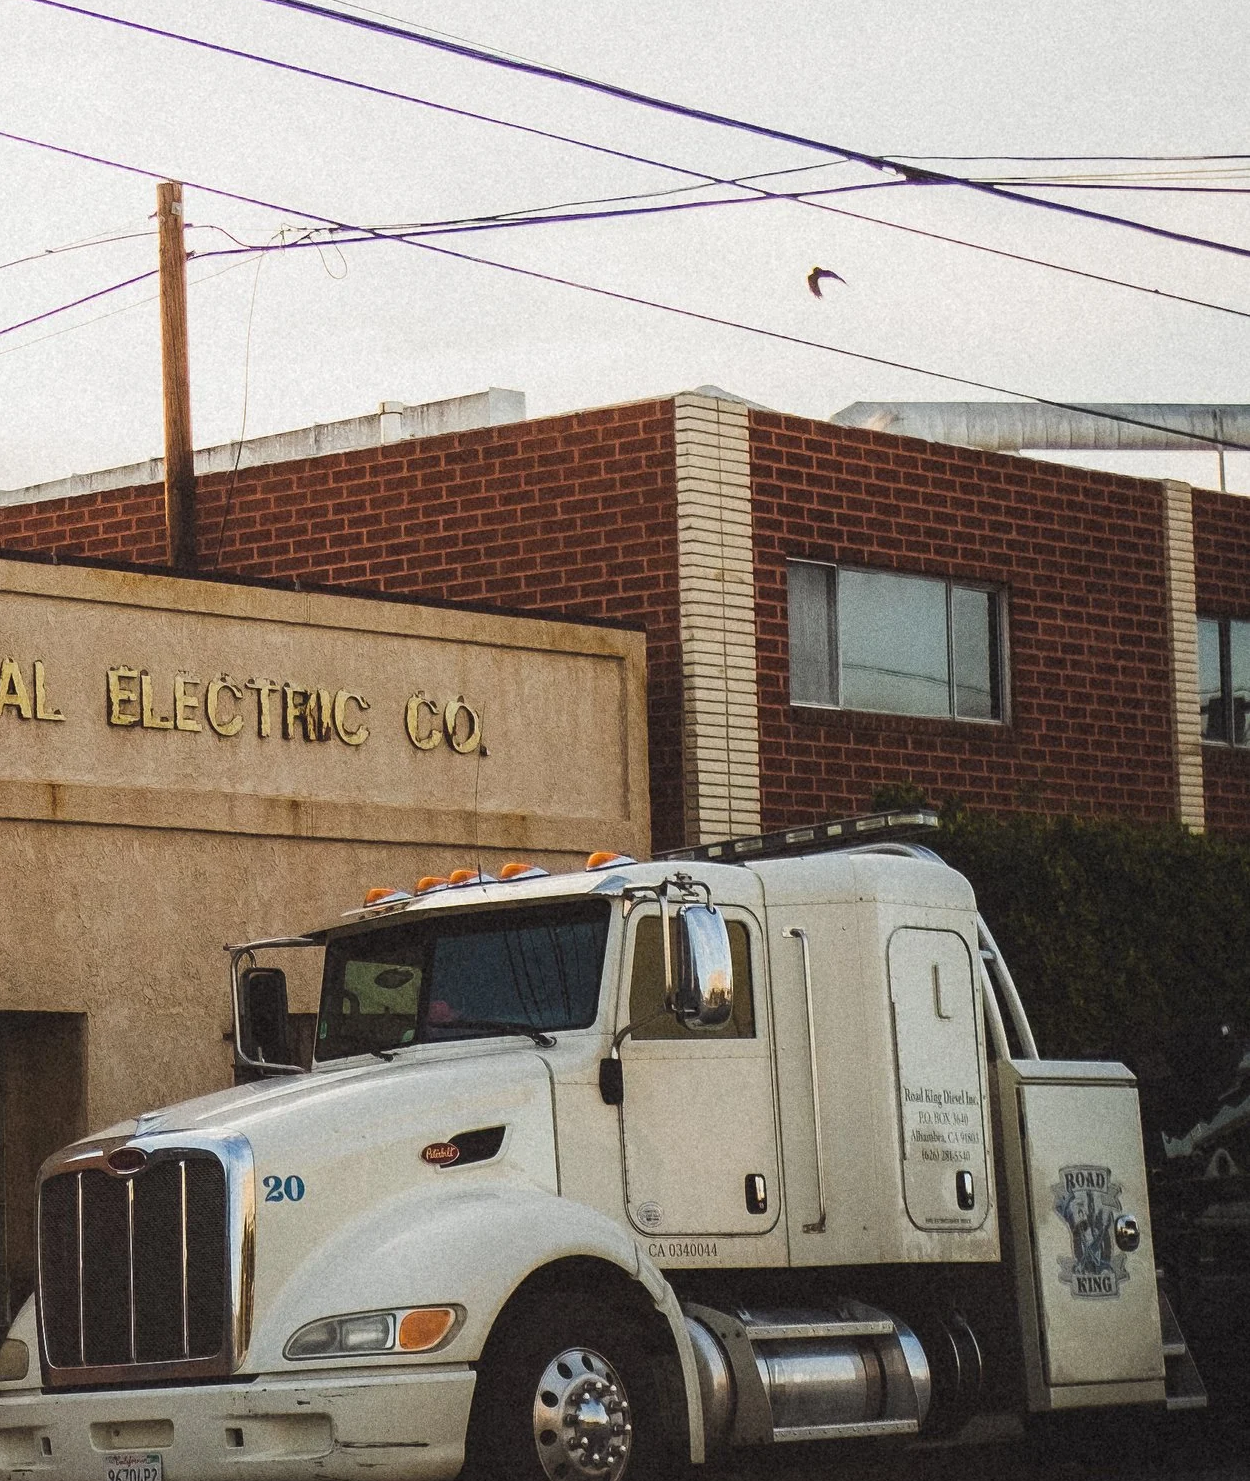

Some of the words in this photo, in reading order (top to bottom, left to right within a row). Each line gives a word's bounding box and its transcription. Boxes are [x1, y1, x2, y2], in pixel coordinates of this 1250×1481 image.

[106, 665, 371, 747] ELECTRIC
[404, 690, 489, 757] CO.
[904, 1087, 924, 1103] Road
[925, 1088, 942, 1108] King
[943, 1089, 965, 1105] Diesel
[965, 1091, 979, 1106] Inc.
[918, 1110, 933, 1125] P.O.
[934, 1112, 950, 1126] BOX
[947, 1131, 959, 1144] CA
[921, 1148, 939, 1162] (626)
[262, 1175, 305, 1202] 20
[1064, 1171, 1105, 1190] ROAD
[648, 1243, 665, 1257] CA
[669, 1242, 717, 1257] 0340044
[1076, 1276, 1112, 1294] KING
